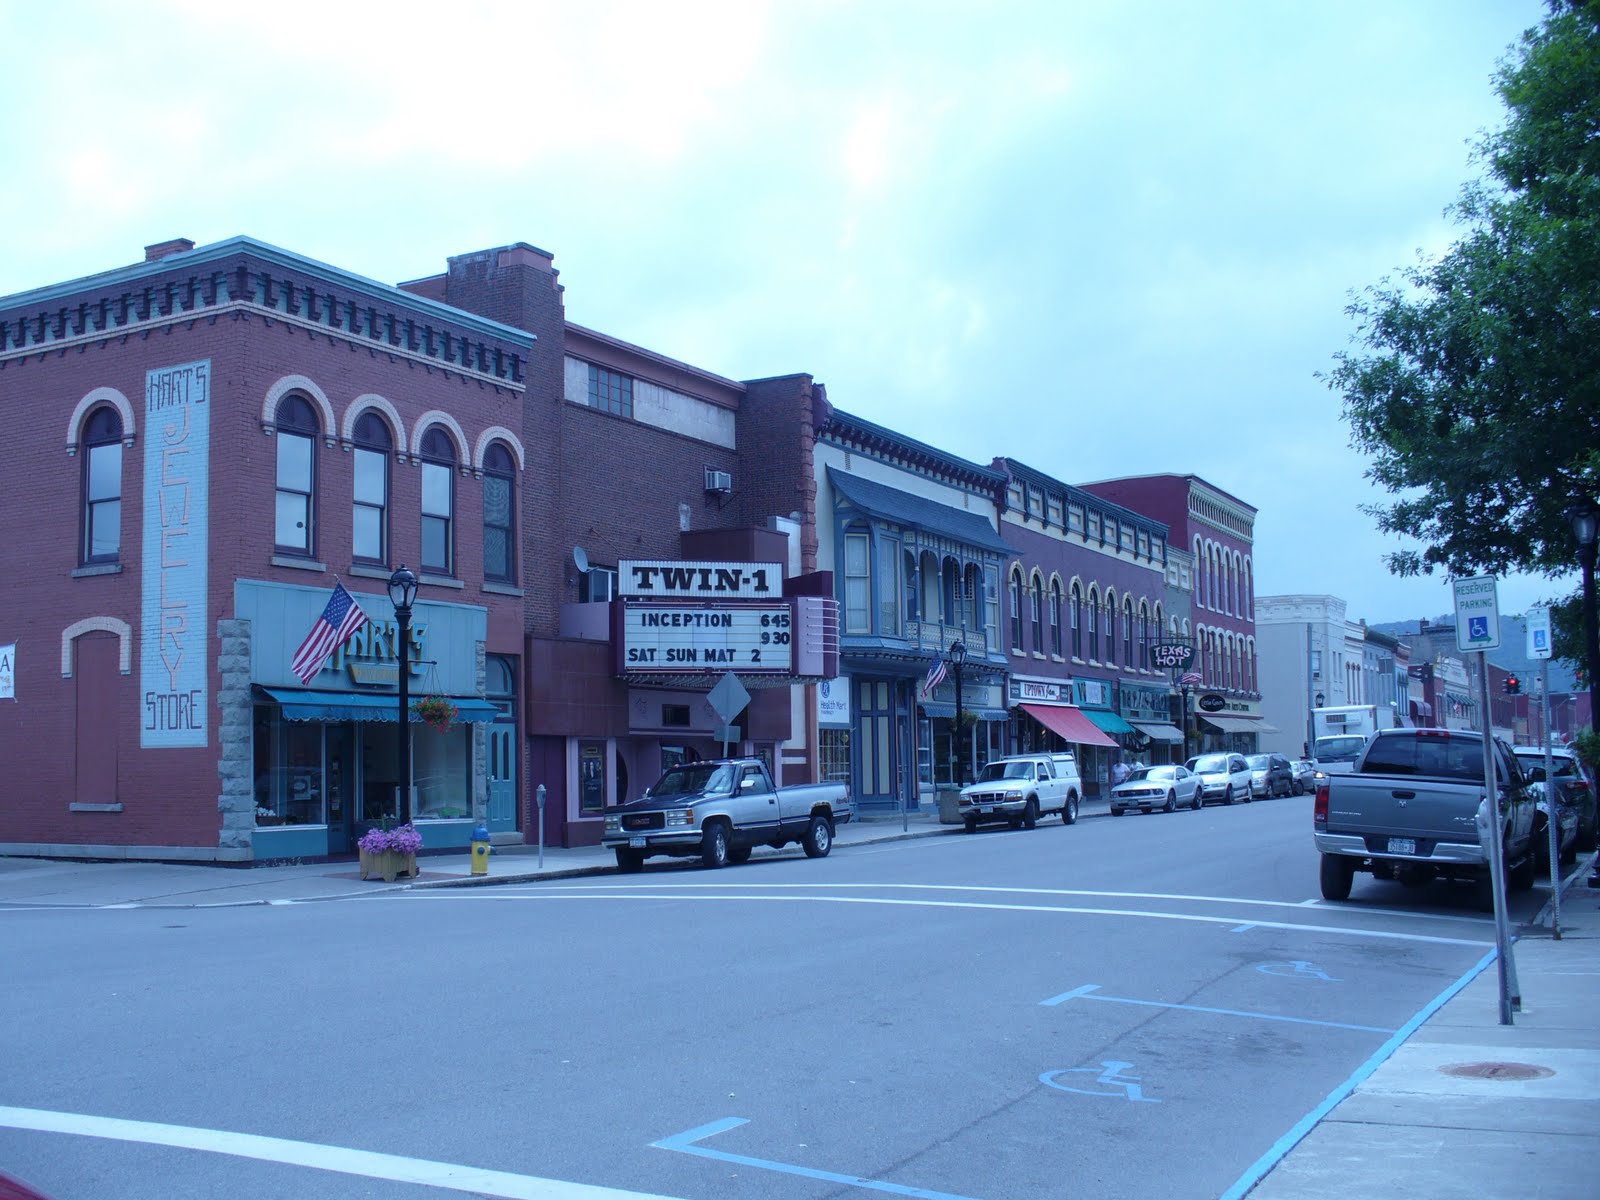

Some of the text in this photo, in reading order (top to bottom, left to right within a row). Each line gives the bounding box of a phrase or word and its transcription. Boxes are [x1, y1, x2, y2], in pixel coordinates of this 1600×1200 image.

[147, 364, 206, 412] HART'S
[158, 405, 191, 692] JEWELRY
[632, 566, 769, 592] TWIN-1
[1455, 583, 1494, 596] RESERVED
[1460, 599, 1493, 610] PARKING
[641, 613, 790, 628] INCEPTION 645
[628, 648, 761, 663] SAT SUN MAT 2
[1153, 645, 1191, 658] TEXAS
[1155, 655, 1185, 666] HOT
[145, 690, 202, 730] STORE
